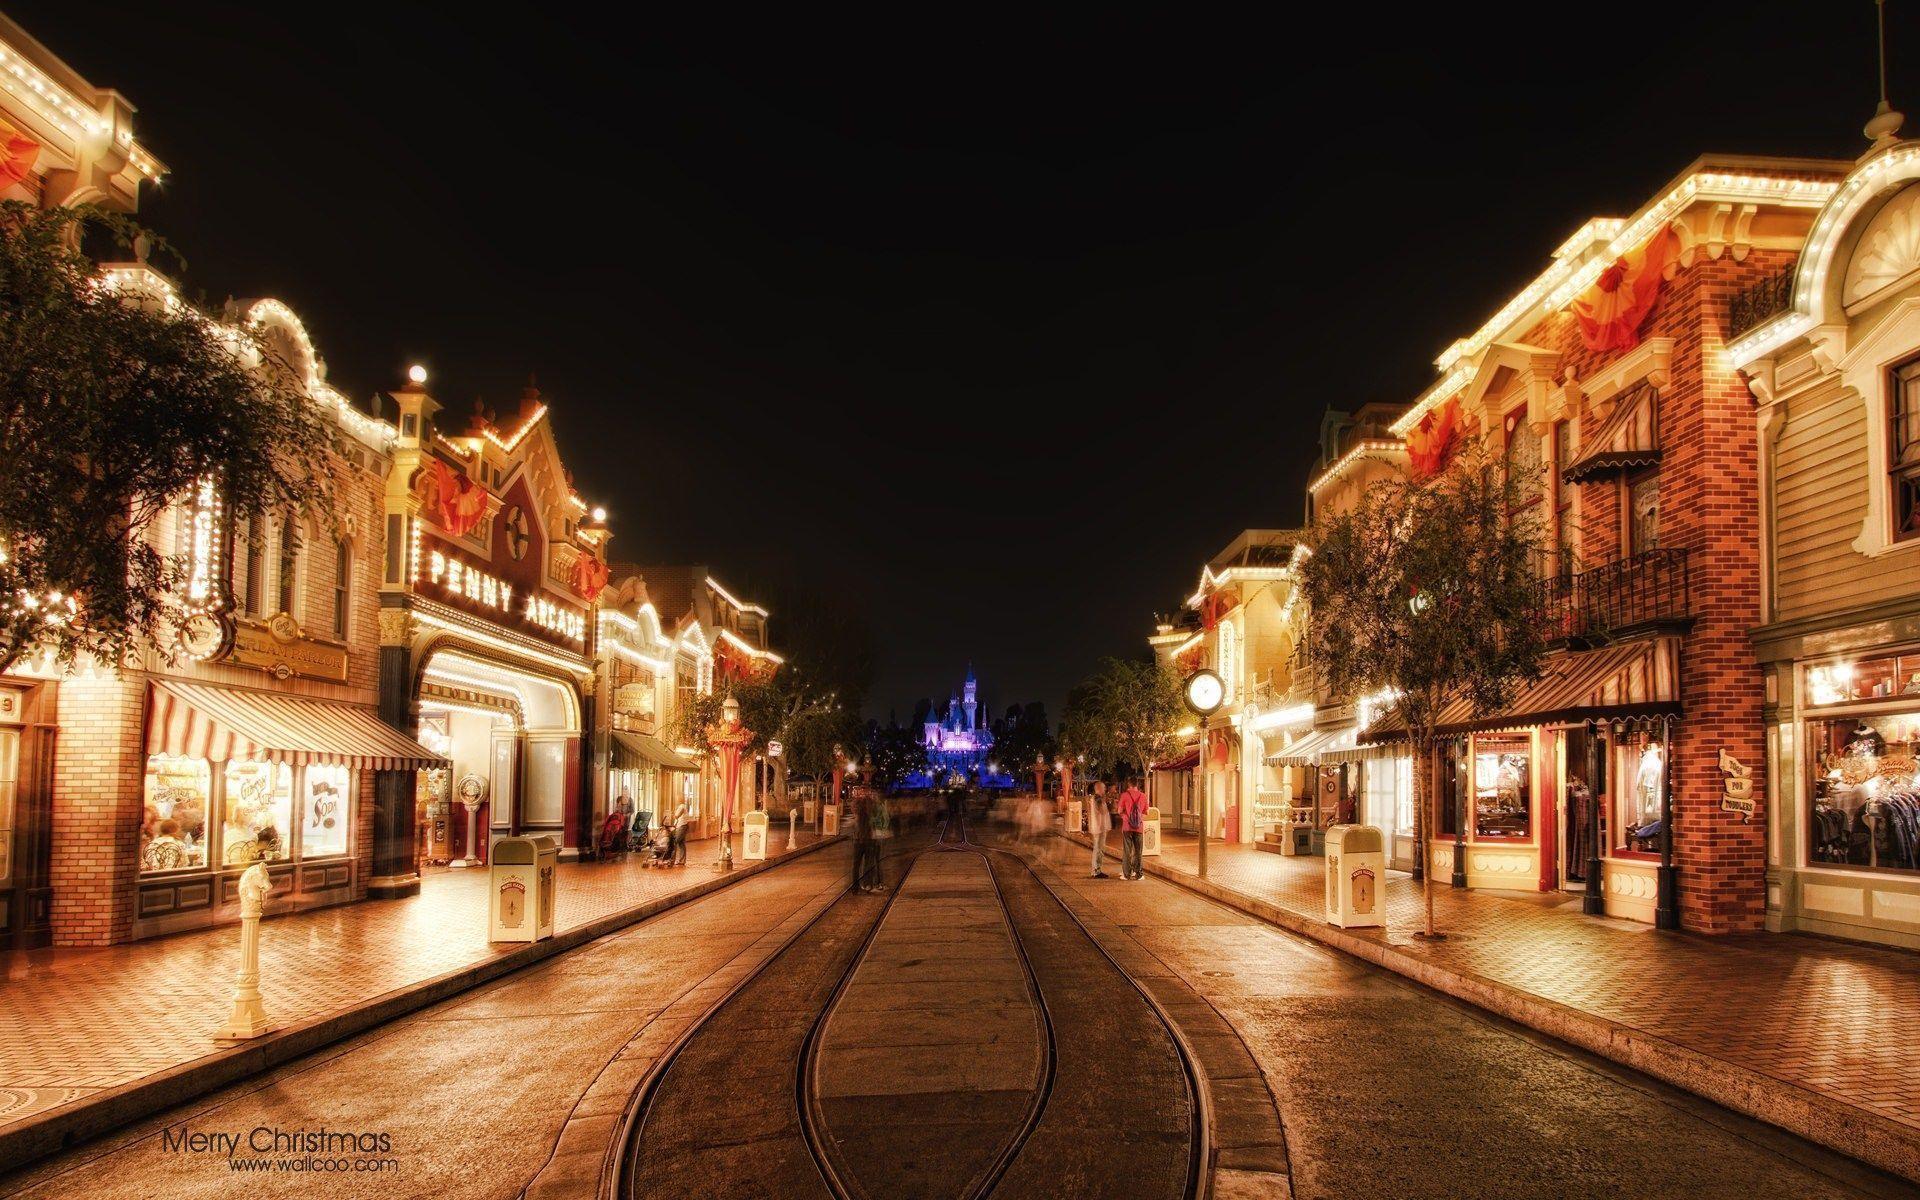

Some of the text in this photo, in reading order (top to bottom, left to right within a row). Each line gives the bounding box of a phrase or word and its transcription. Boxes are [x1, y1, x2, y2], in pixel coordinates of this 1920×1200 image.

[431, 550, 584, 641] PENNY ARCADE
[240, 638, 344, 669] REAM PARLOR
